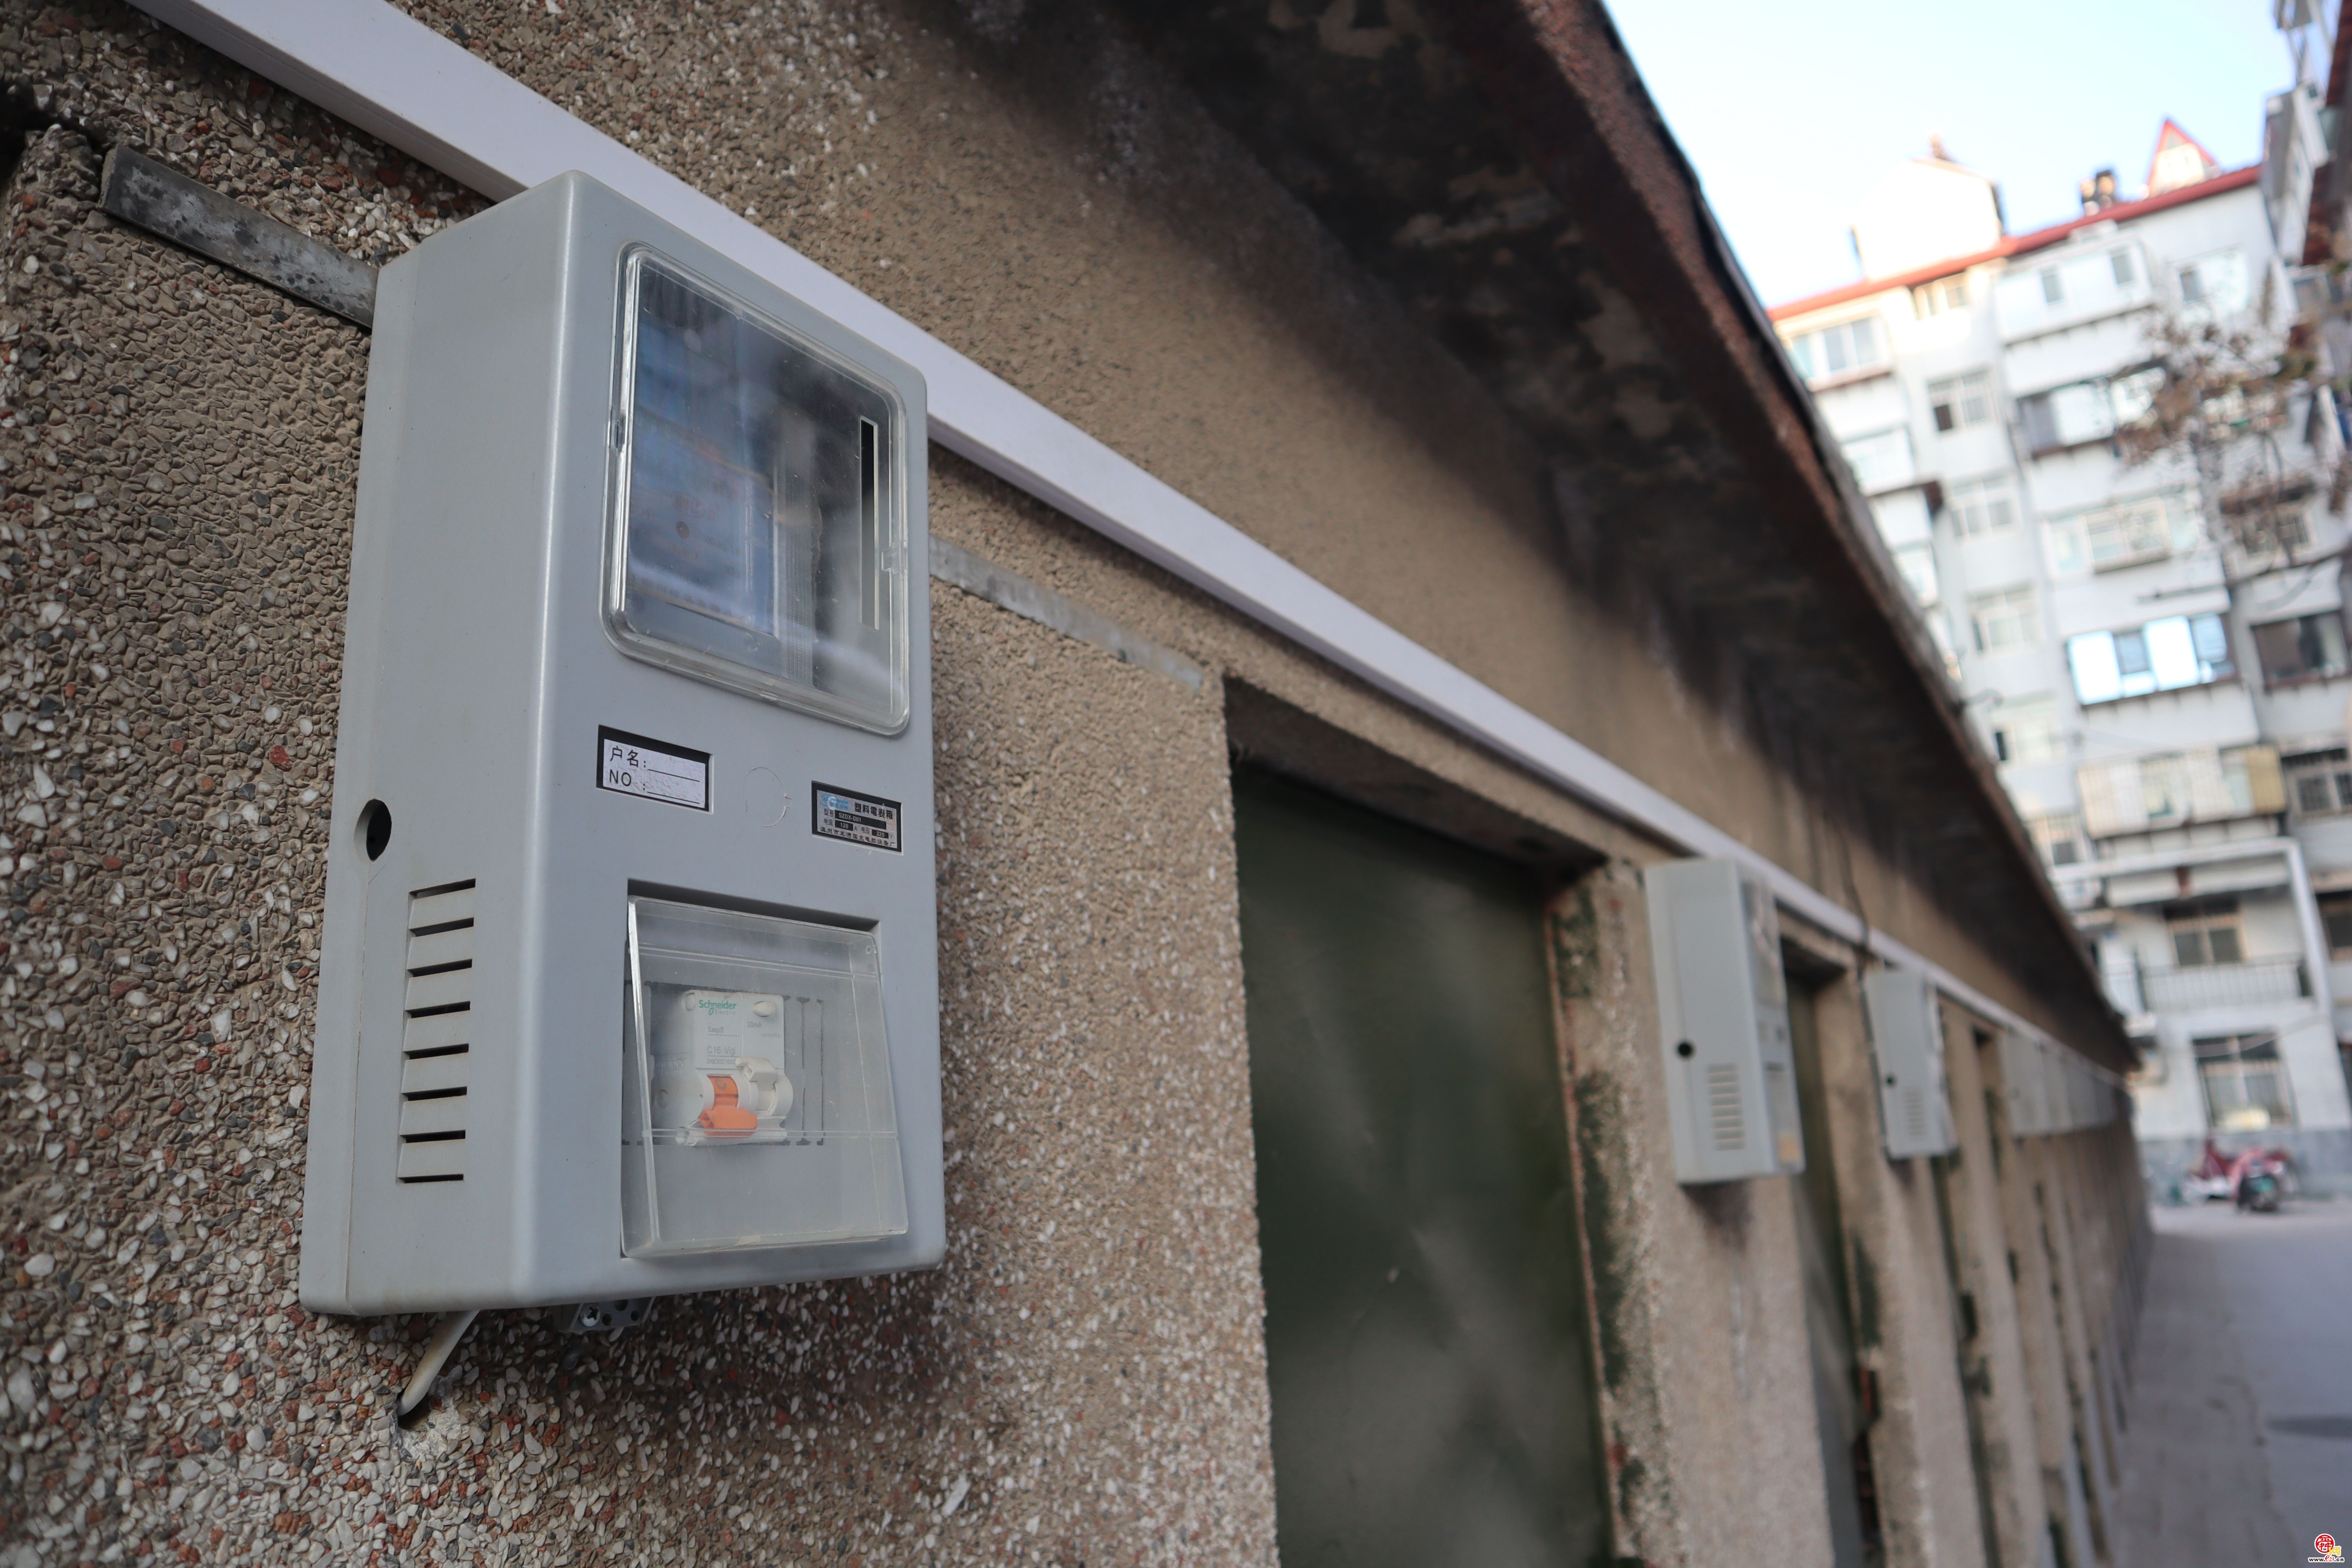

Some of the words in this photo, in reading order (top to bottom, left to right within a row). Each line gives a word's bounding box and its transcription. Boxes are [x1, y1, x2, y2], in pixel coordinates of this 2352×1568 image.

[824, 808, 834, 817] 型号
[699, 1000, 737, 1009] Schneider
[708, 1026, 724, 1034] Easy9
[707, 1045, 720, 1054] C16
[724, 1046, 736, 1056] Vigi
